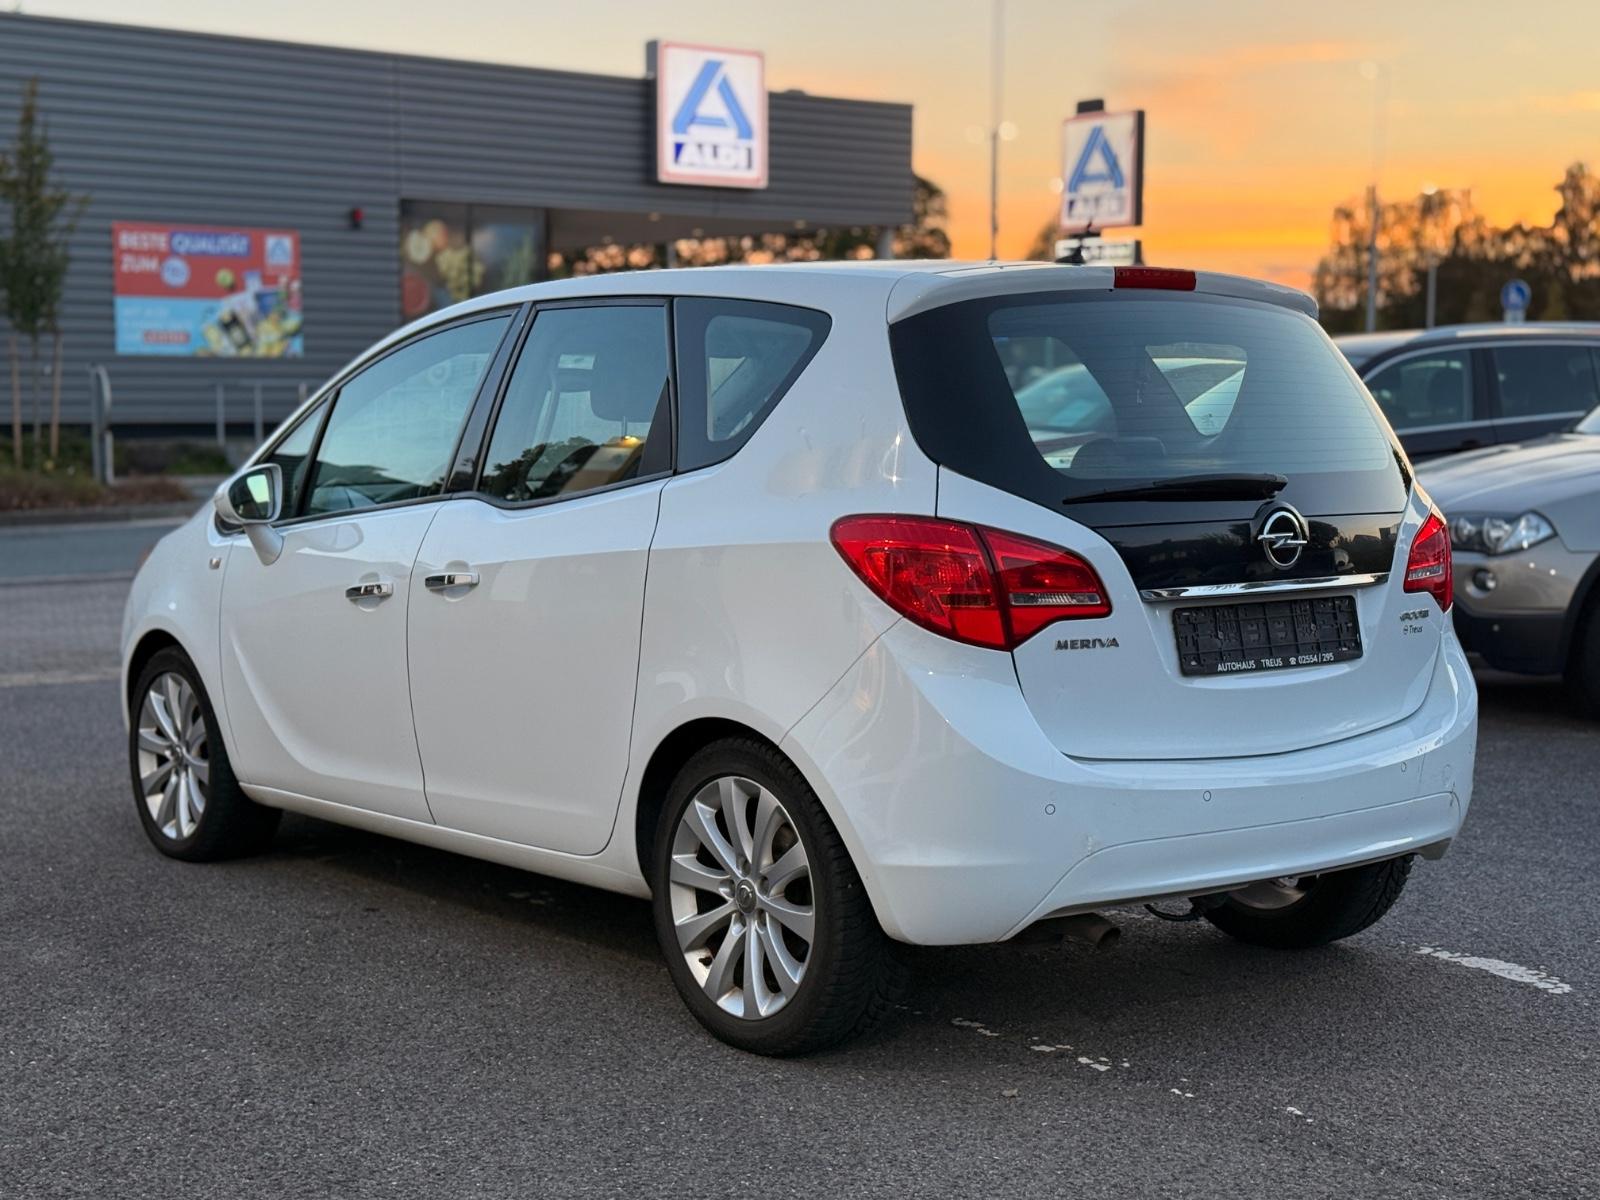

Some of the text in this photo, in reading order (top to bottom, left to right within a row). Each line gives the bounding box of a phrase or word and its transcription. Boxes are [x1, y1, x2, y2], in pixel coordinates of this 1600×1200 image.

[674, 142, 752, 171] ALDI
[118, 231, 168, 251] BESTE
[120, 253, 159, 273] ZUM
[1055, 637, 1119, 650] MERIVA
[1217, 660, 1256, 672] AUTOHAUS
[1261, 657, 1283, 668] TREUS
